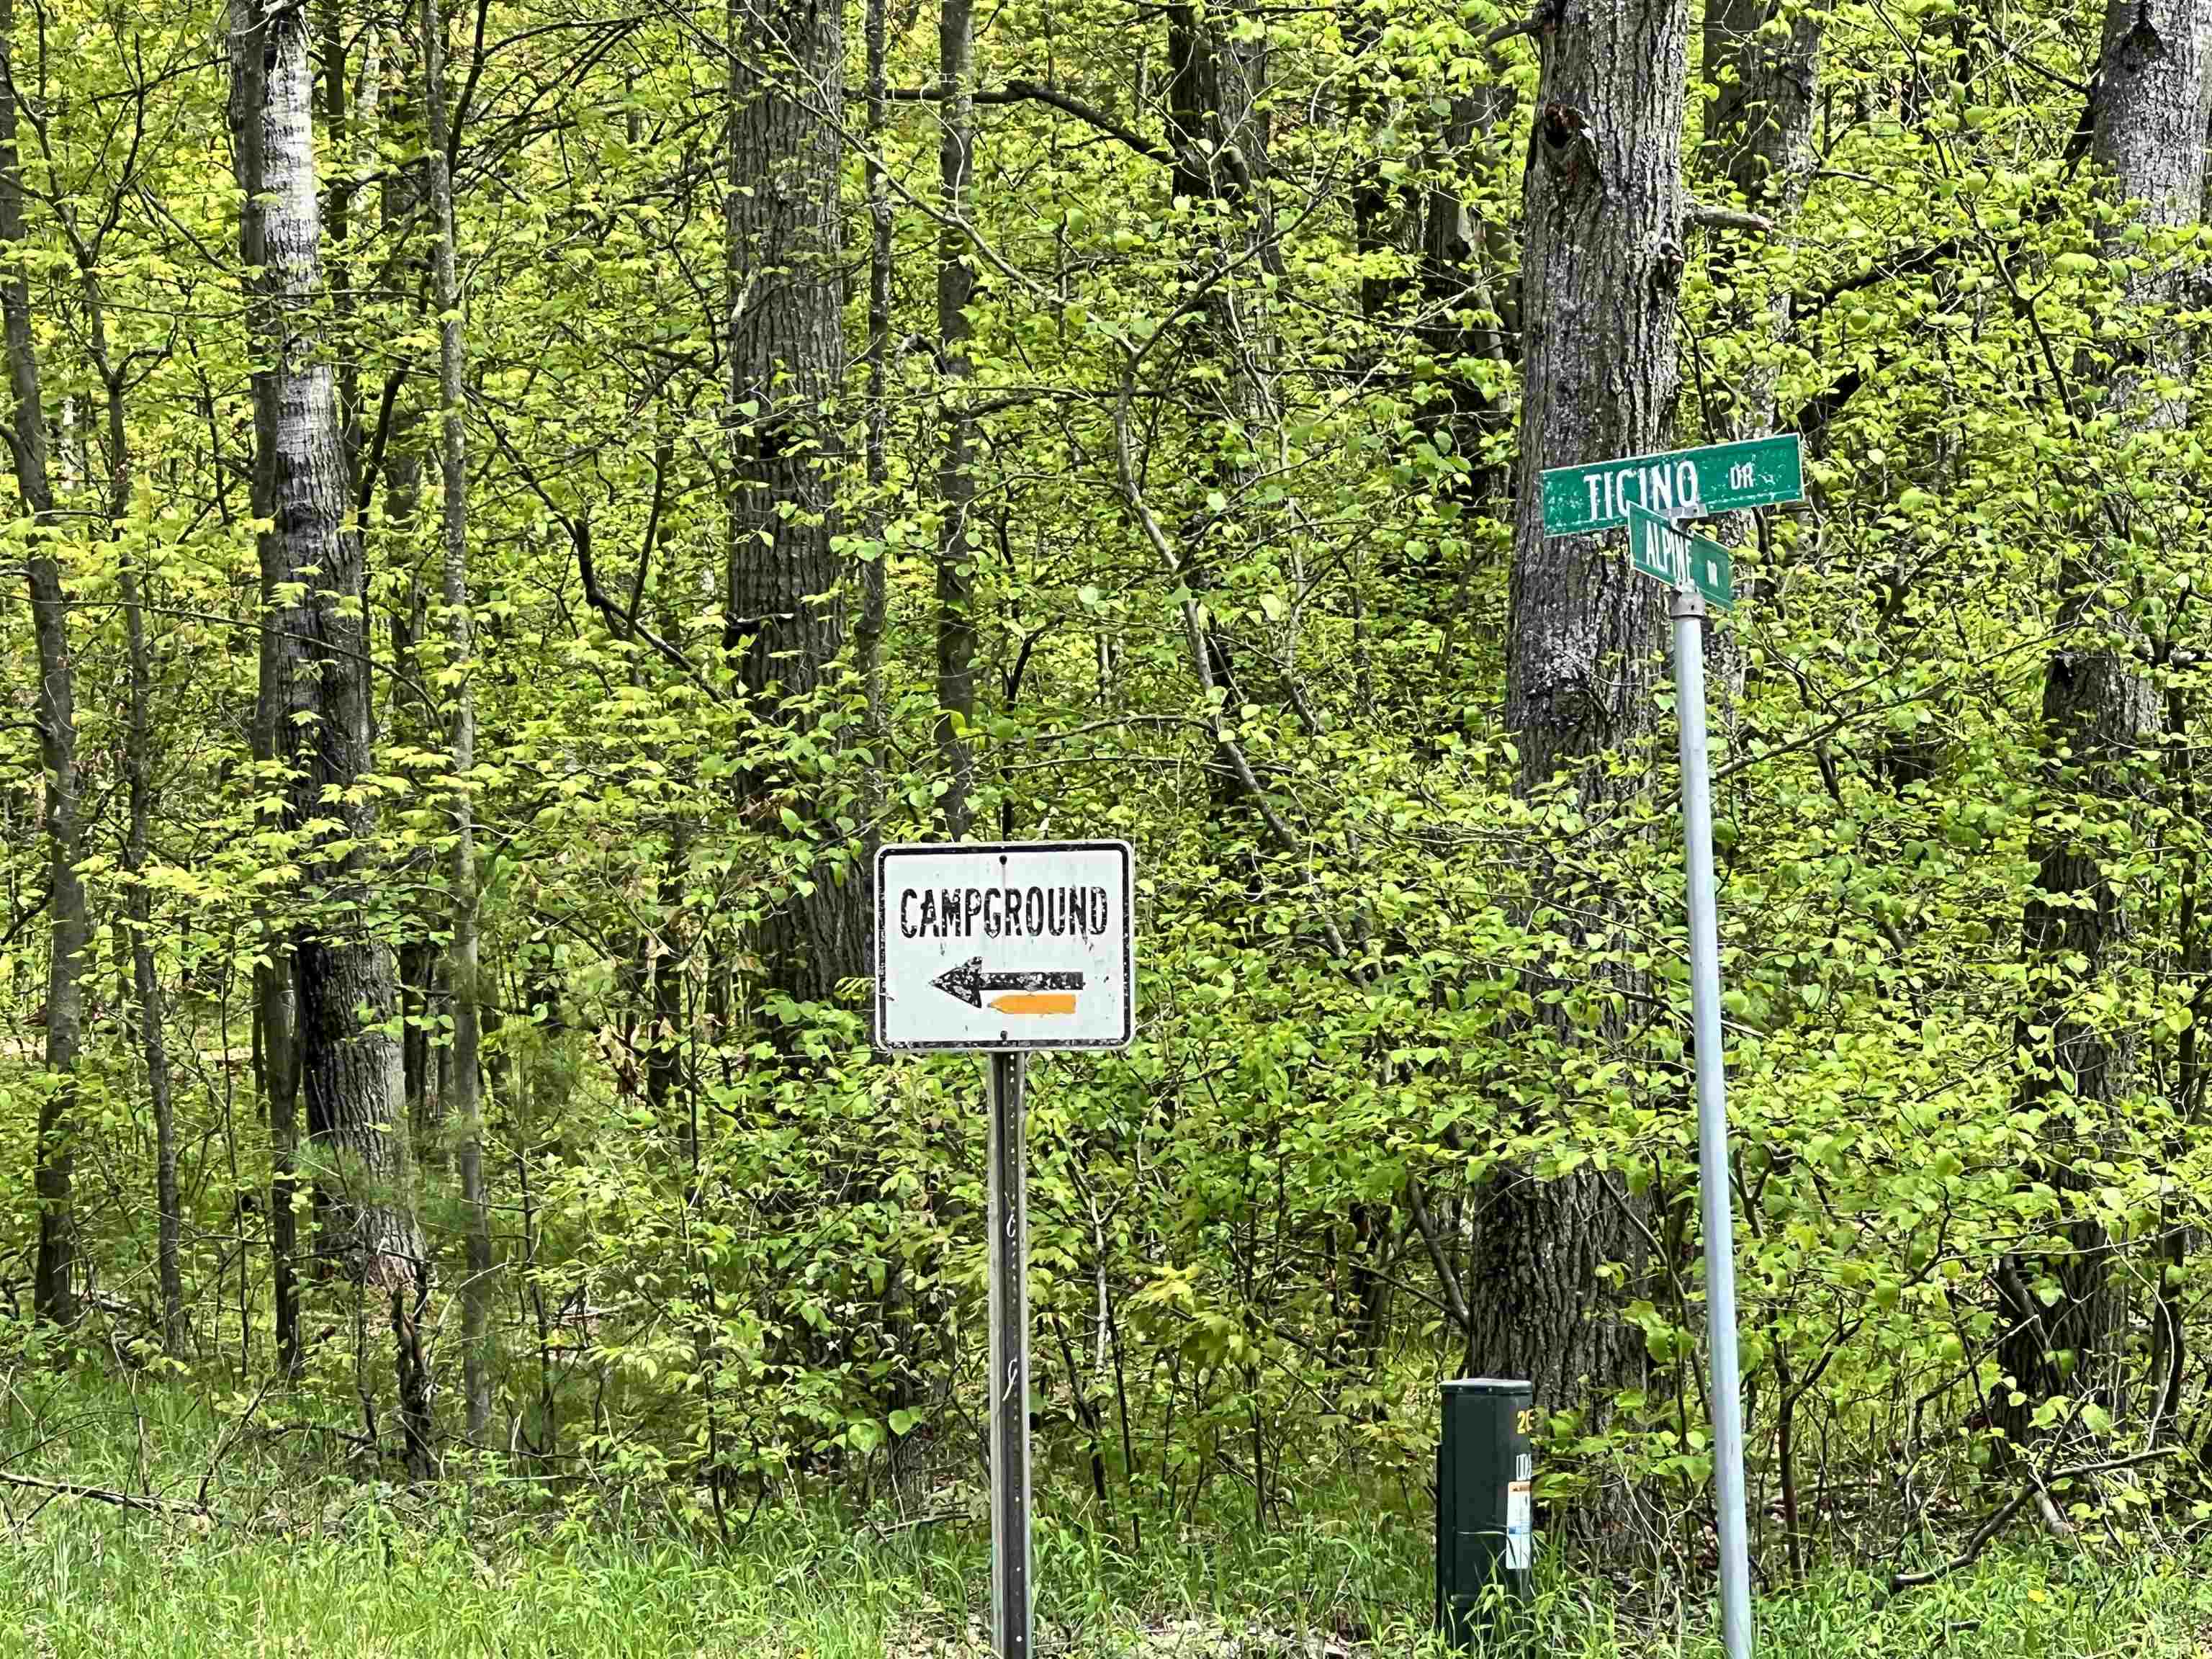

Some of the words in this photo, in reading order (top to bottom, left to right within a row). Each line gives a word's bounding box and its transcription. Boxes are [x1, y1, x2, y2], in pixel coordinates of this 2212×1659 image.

[1584, 462, 1699, 520] TICINO
[1730, 462, 1755, 490] DR
[1646, 520, 1693, 582] ALPINE
[900, 886, 1108, 938] CAMPGROUND
